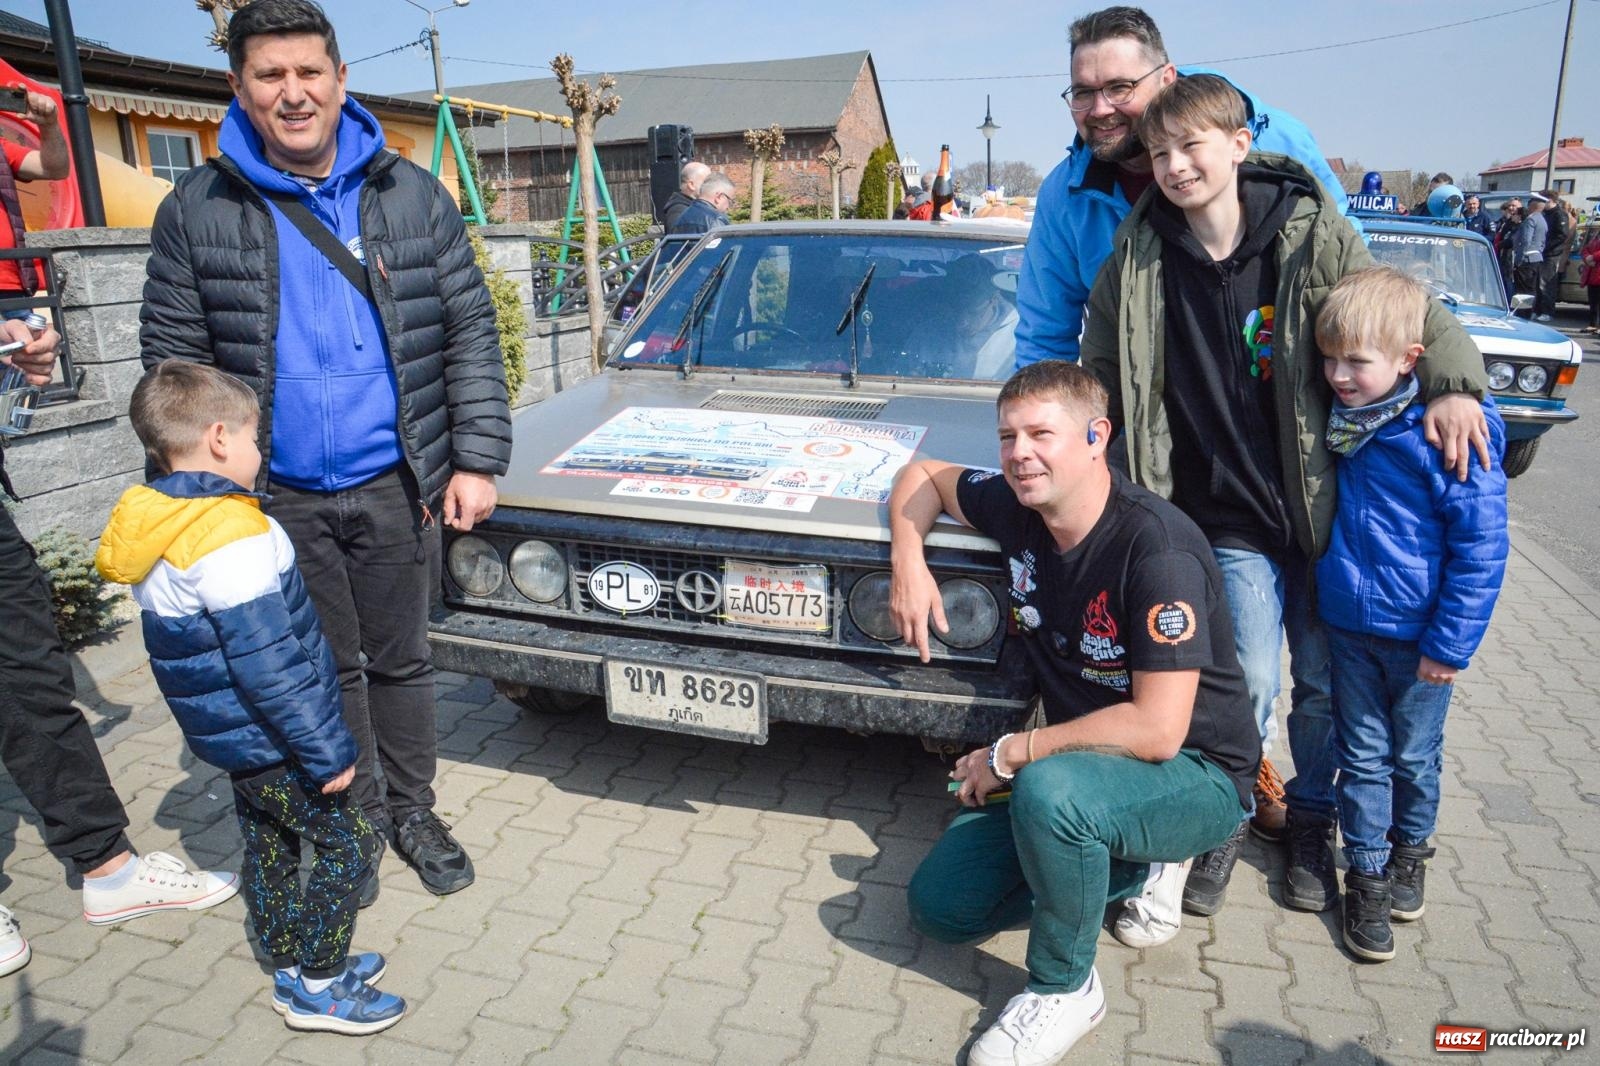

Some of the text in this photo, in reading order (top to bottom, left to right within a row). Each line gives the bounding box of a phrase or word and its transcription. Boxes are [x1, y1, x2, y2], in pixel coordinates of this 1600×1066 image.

[1347, 195, 1394, 210] MILICJA
[594, 570, 654, 604] 19 PL 81
[744, 575, 806, 593] 临时入境
[682, 674, 755, 709] 8629
